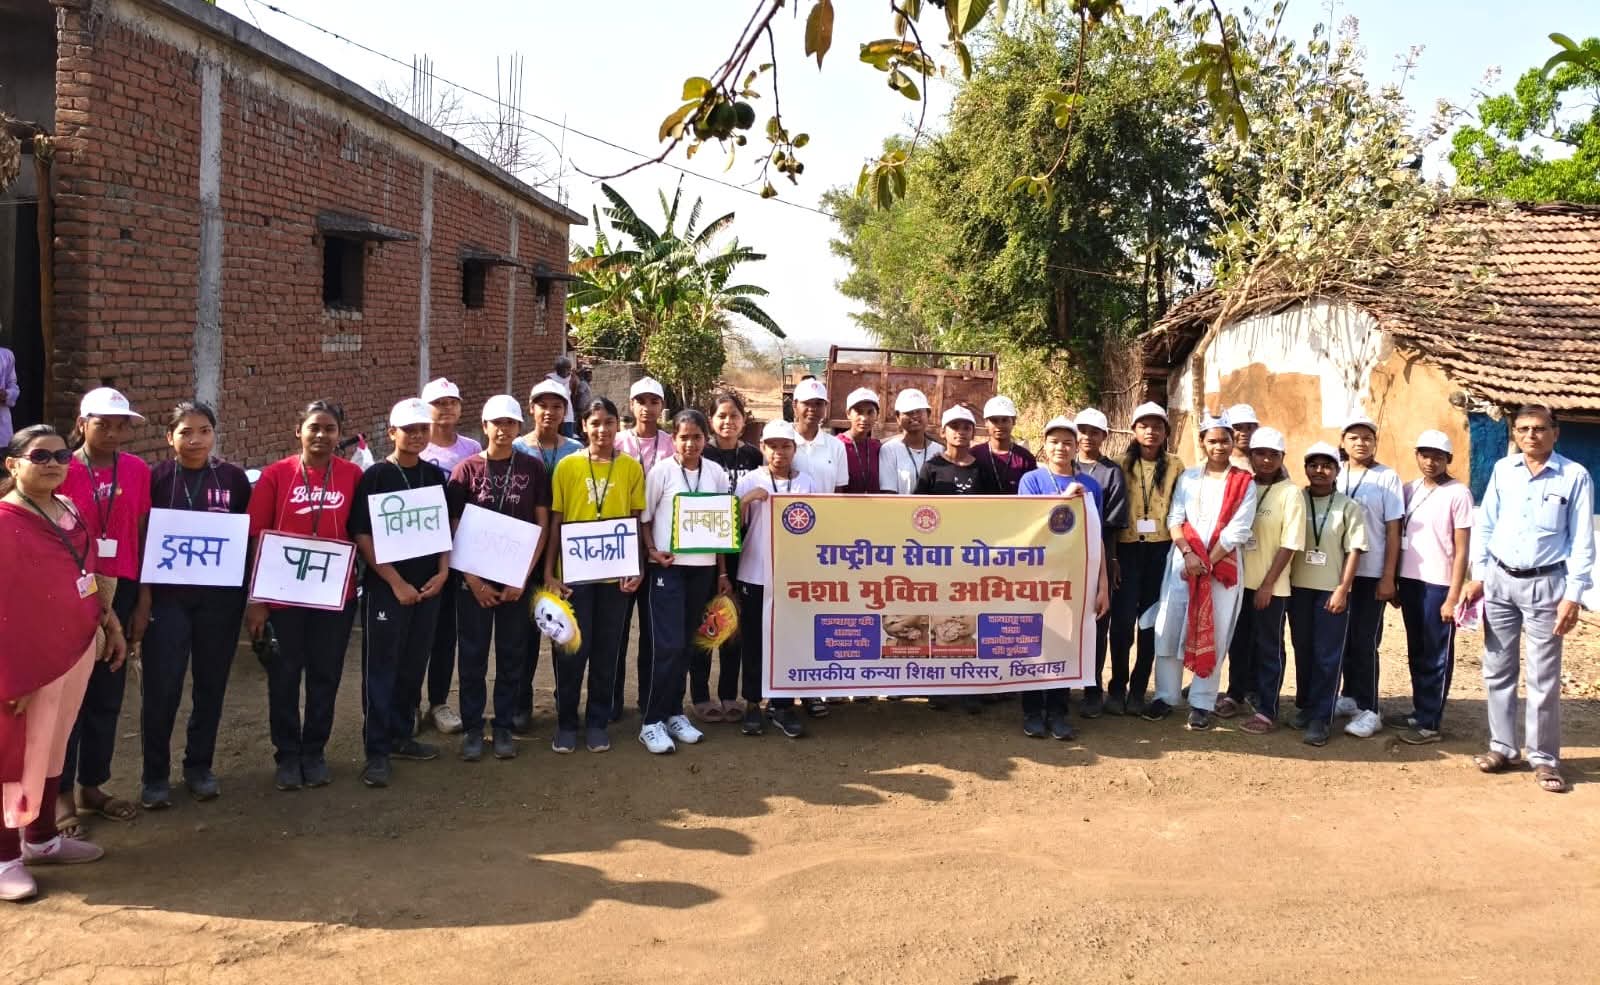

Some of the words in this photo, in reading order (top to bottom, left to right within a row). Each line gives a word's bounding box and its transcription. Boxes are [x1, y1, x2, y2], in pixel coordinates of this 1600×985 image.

[378, 495, 442, 537] विमल
[567, 522, 637, 561] राजश्री
[815, 539, 896, 570] राष्ट्रीय
[902, 538, 954, 567] सेवा
[960, 539, 1046, 567] योजना
[283, 545, 341, 582] पान
[787, 579, 850, 602] नशा
[858, 575, 938, 610] मुक्ति
[949, 576, 1073, 602] अभियान
[788, 663, 855, 683] शासकीय
[860, 666, 901, 681] कन्या
[906, 663, 945, 681] शिक्षा
[951, 661, 1003, 681] परिसर,
[1008, 660, 1066, 677] छिंदवाड़ा
